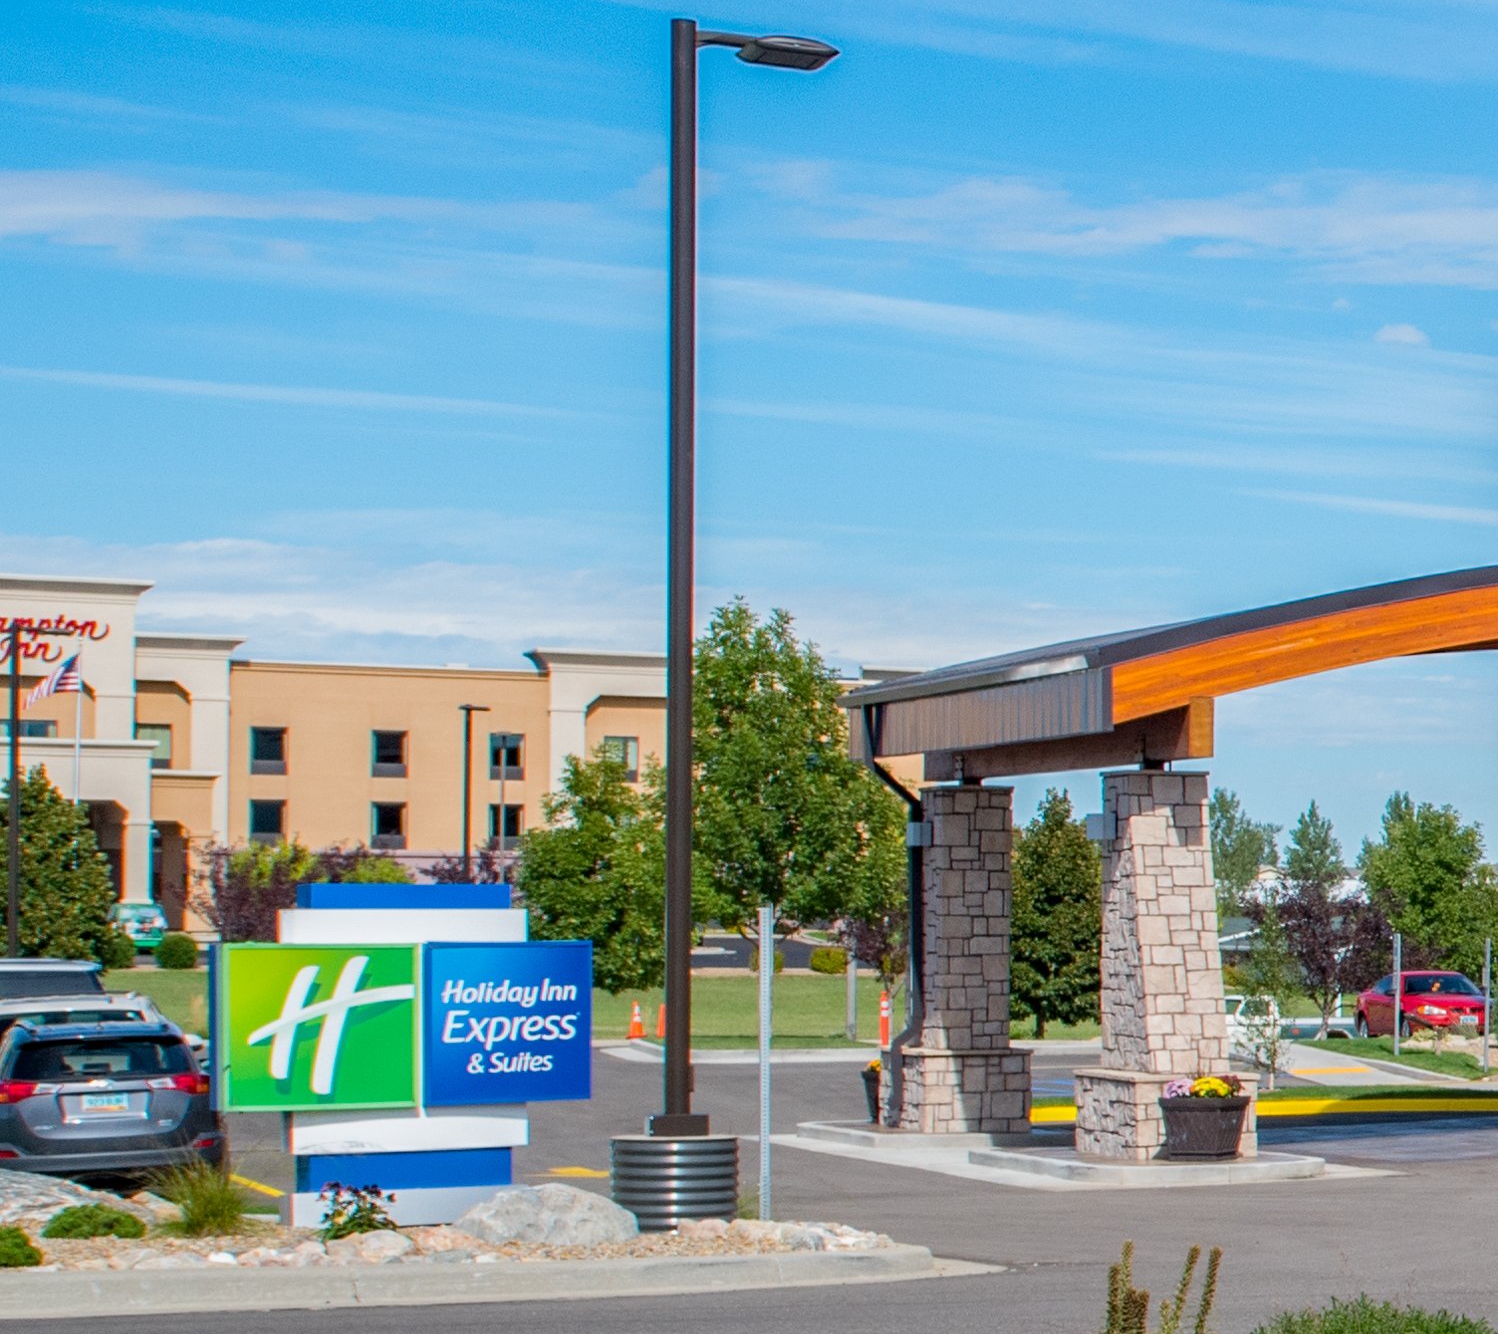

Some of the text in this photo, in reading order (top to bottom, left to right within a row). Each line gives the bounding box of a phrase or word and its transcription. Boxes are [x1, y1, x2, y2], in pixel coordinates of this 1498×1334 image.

[0, 614, 110, 642] ampton
[440, 977, 577, 1008] Holiday Inn
[441, 1009, 578, 1052] Express
[466, 1051, 554, 1075] & Suites
